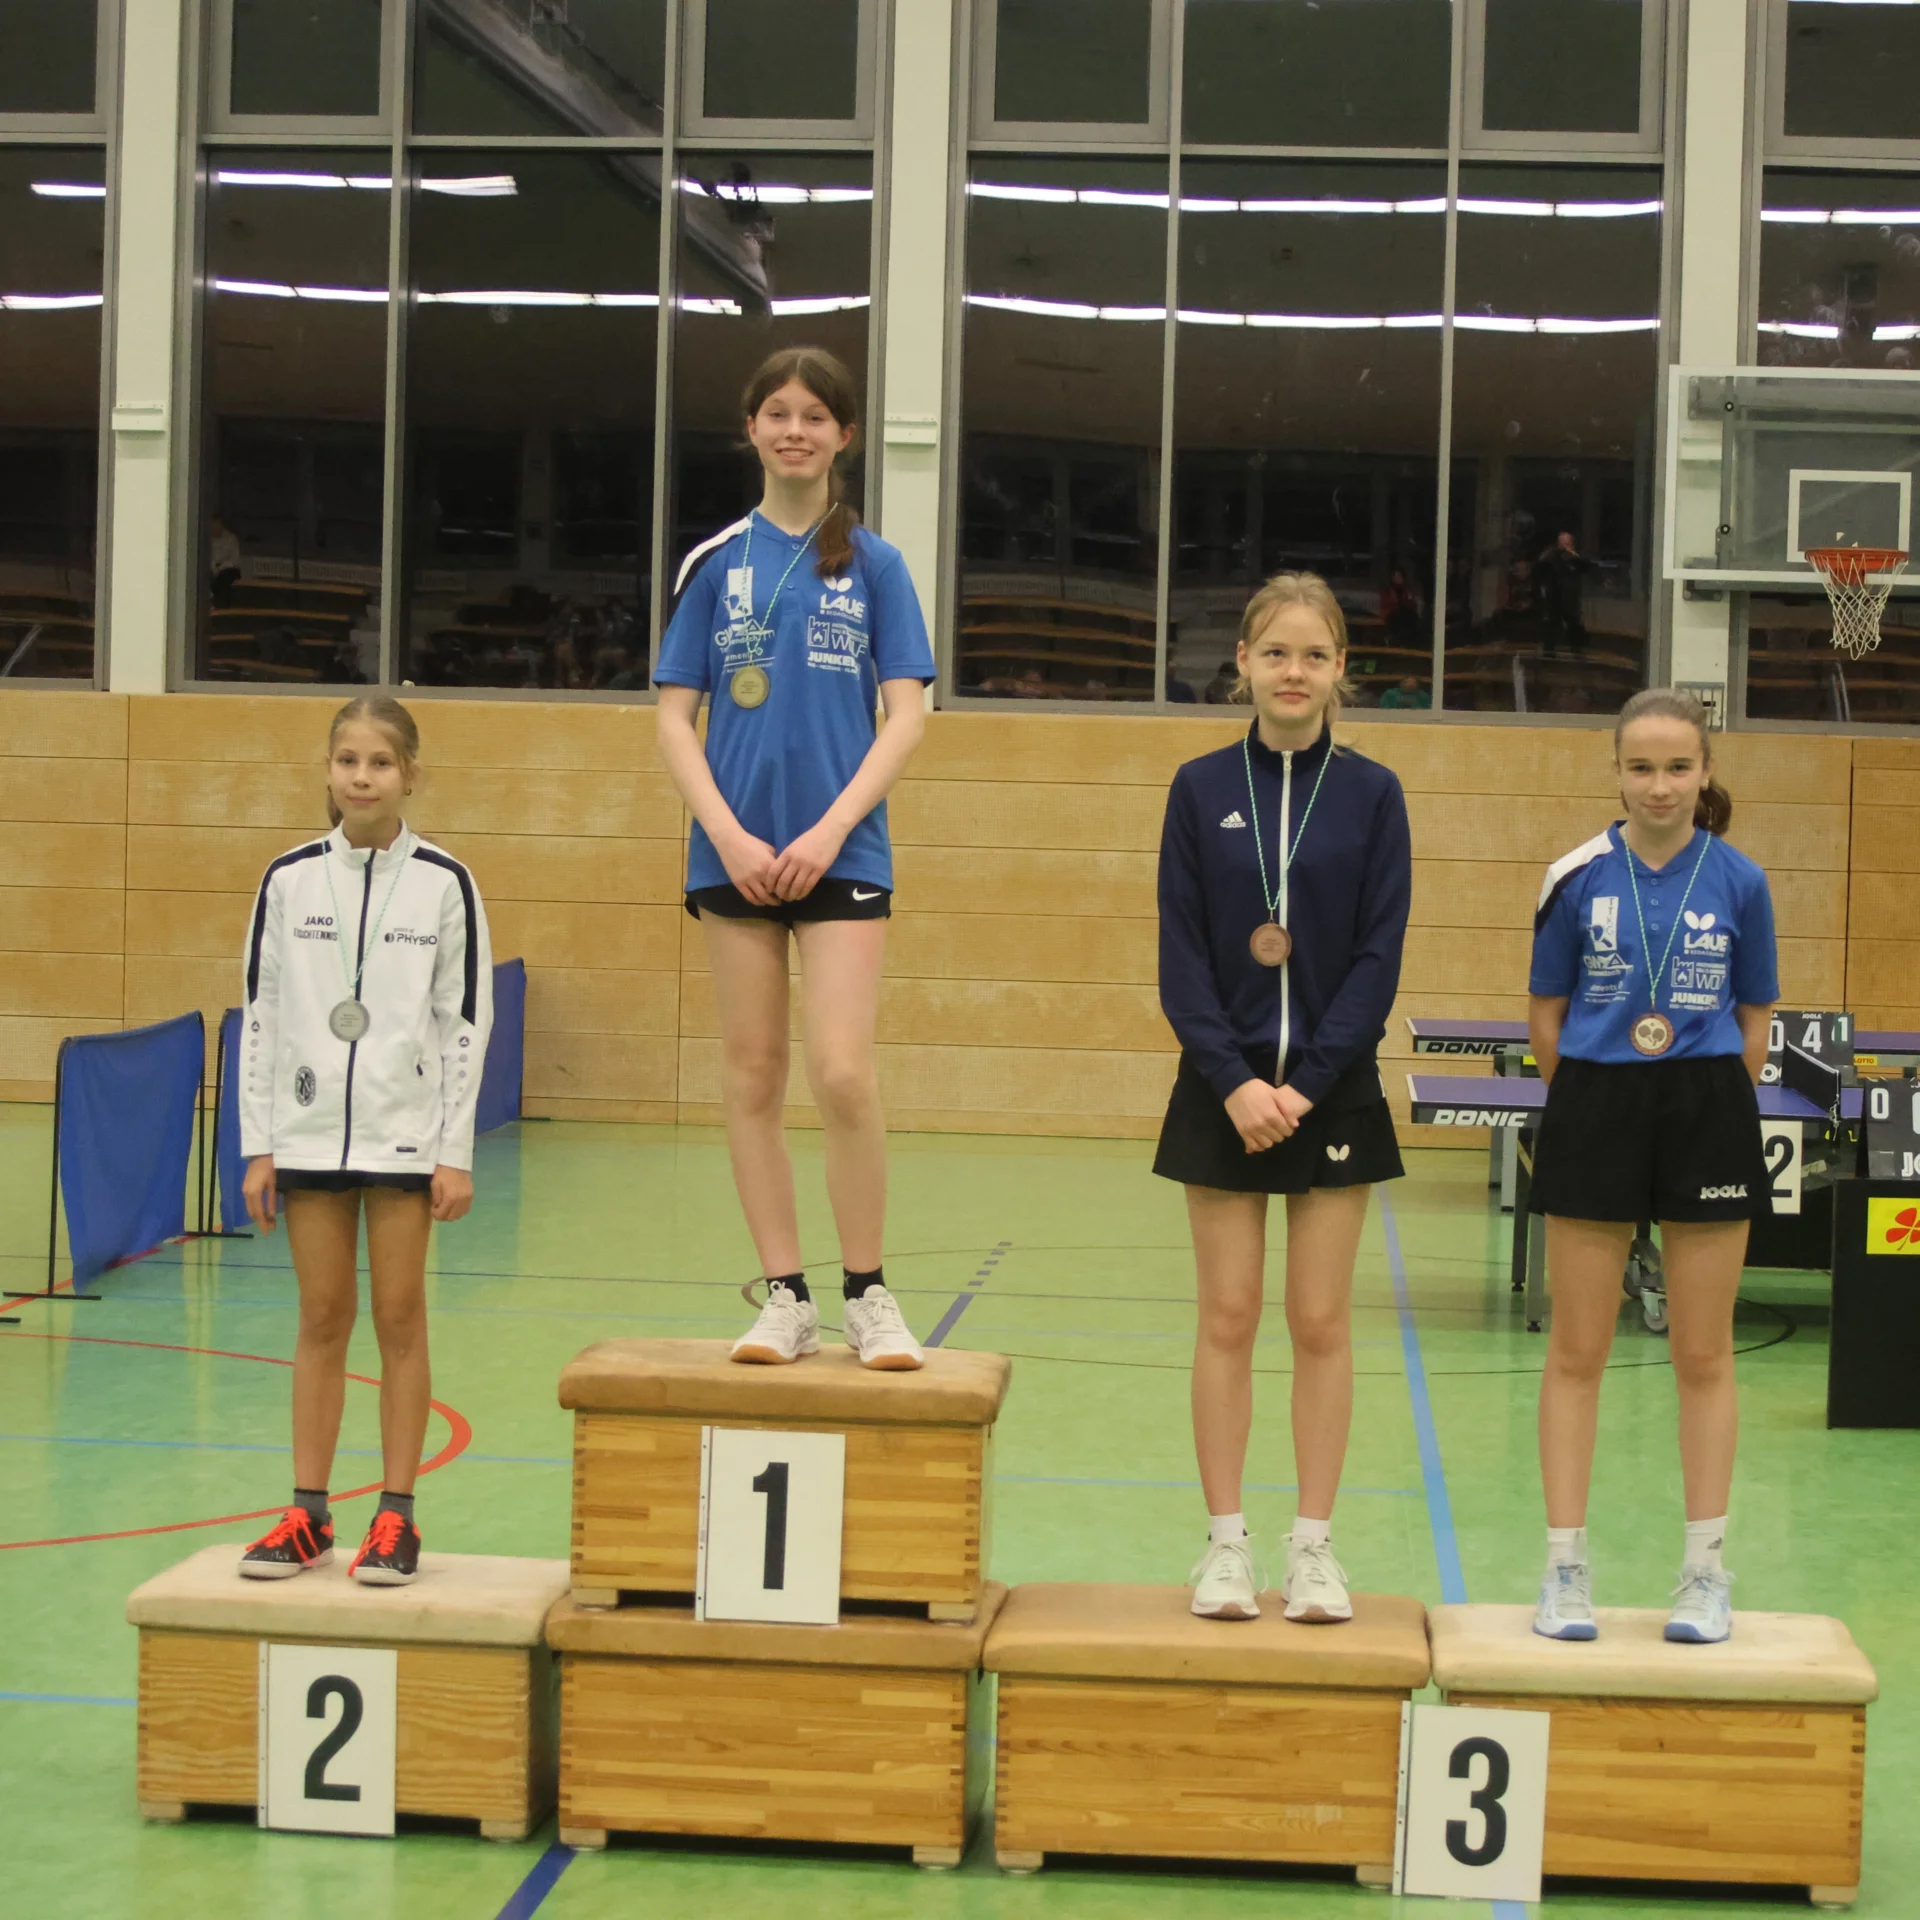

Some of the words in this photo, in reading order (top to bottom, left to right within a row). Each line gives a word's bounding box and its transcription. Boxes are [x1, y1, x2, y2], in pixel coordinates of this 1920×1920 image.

[820, 593, 866, 618] LAUE
[304, 916, 334, 926] JAKO
[396, 933, 438, 945] PHYSIO
[1684, 932, 1728, 952] LAUE
[1801, 1021, 1822, 1053] 4
[1837, 1016, 1849, 1042] 1
[1426, 1042, 1507, 1055] DONIC
[1870, 1088, 1889, 1119] 0
[1432, 1109, 1528, 1127] DONIC
[1764, 1134, 1795, 1198] 2
[1700, 1184, 1748, 1200] JOOLA
[753, 1462, 789, 1590] 1
[304, 1674, 364, 1802] 2
[1445, 1736, 1510, 1867] 3
